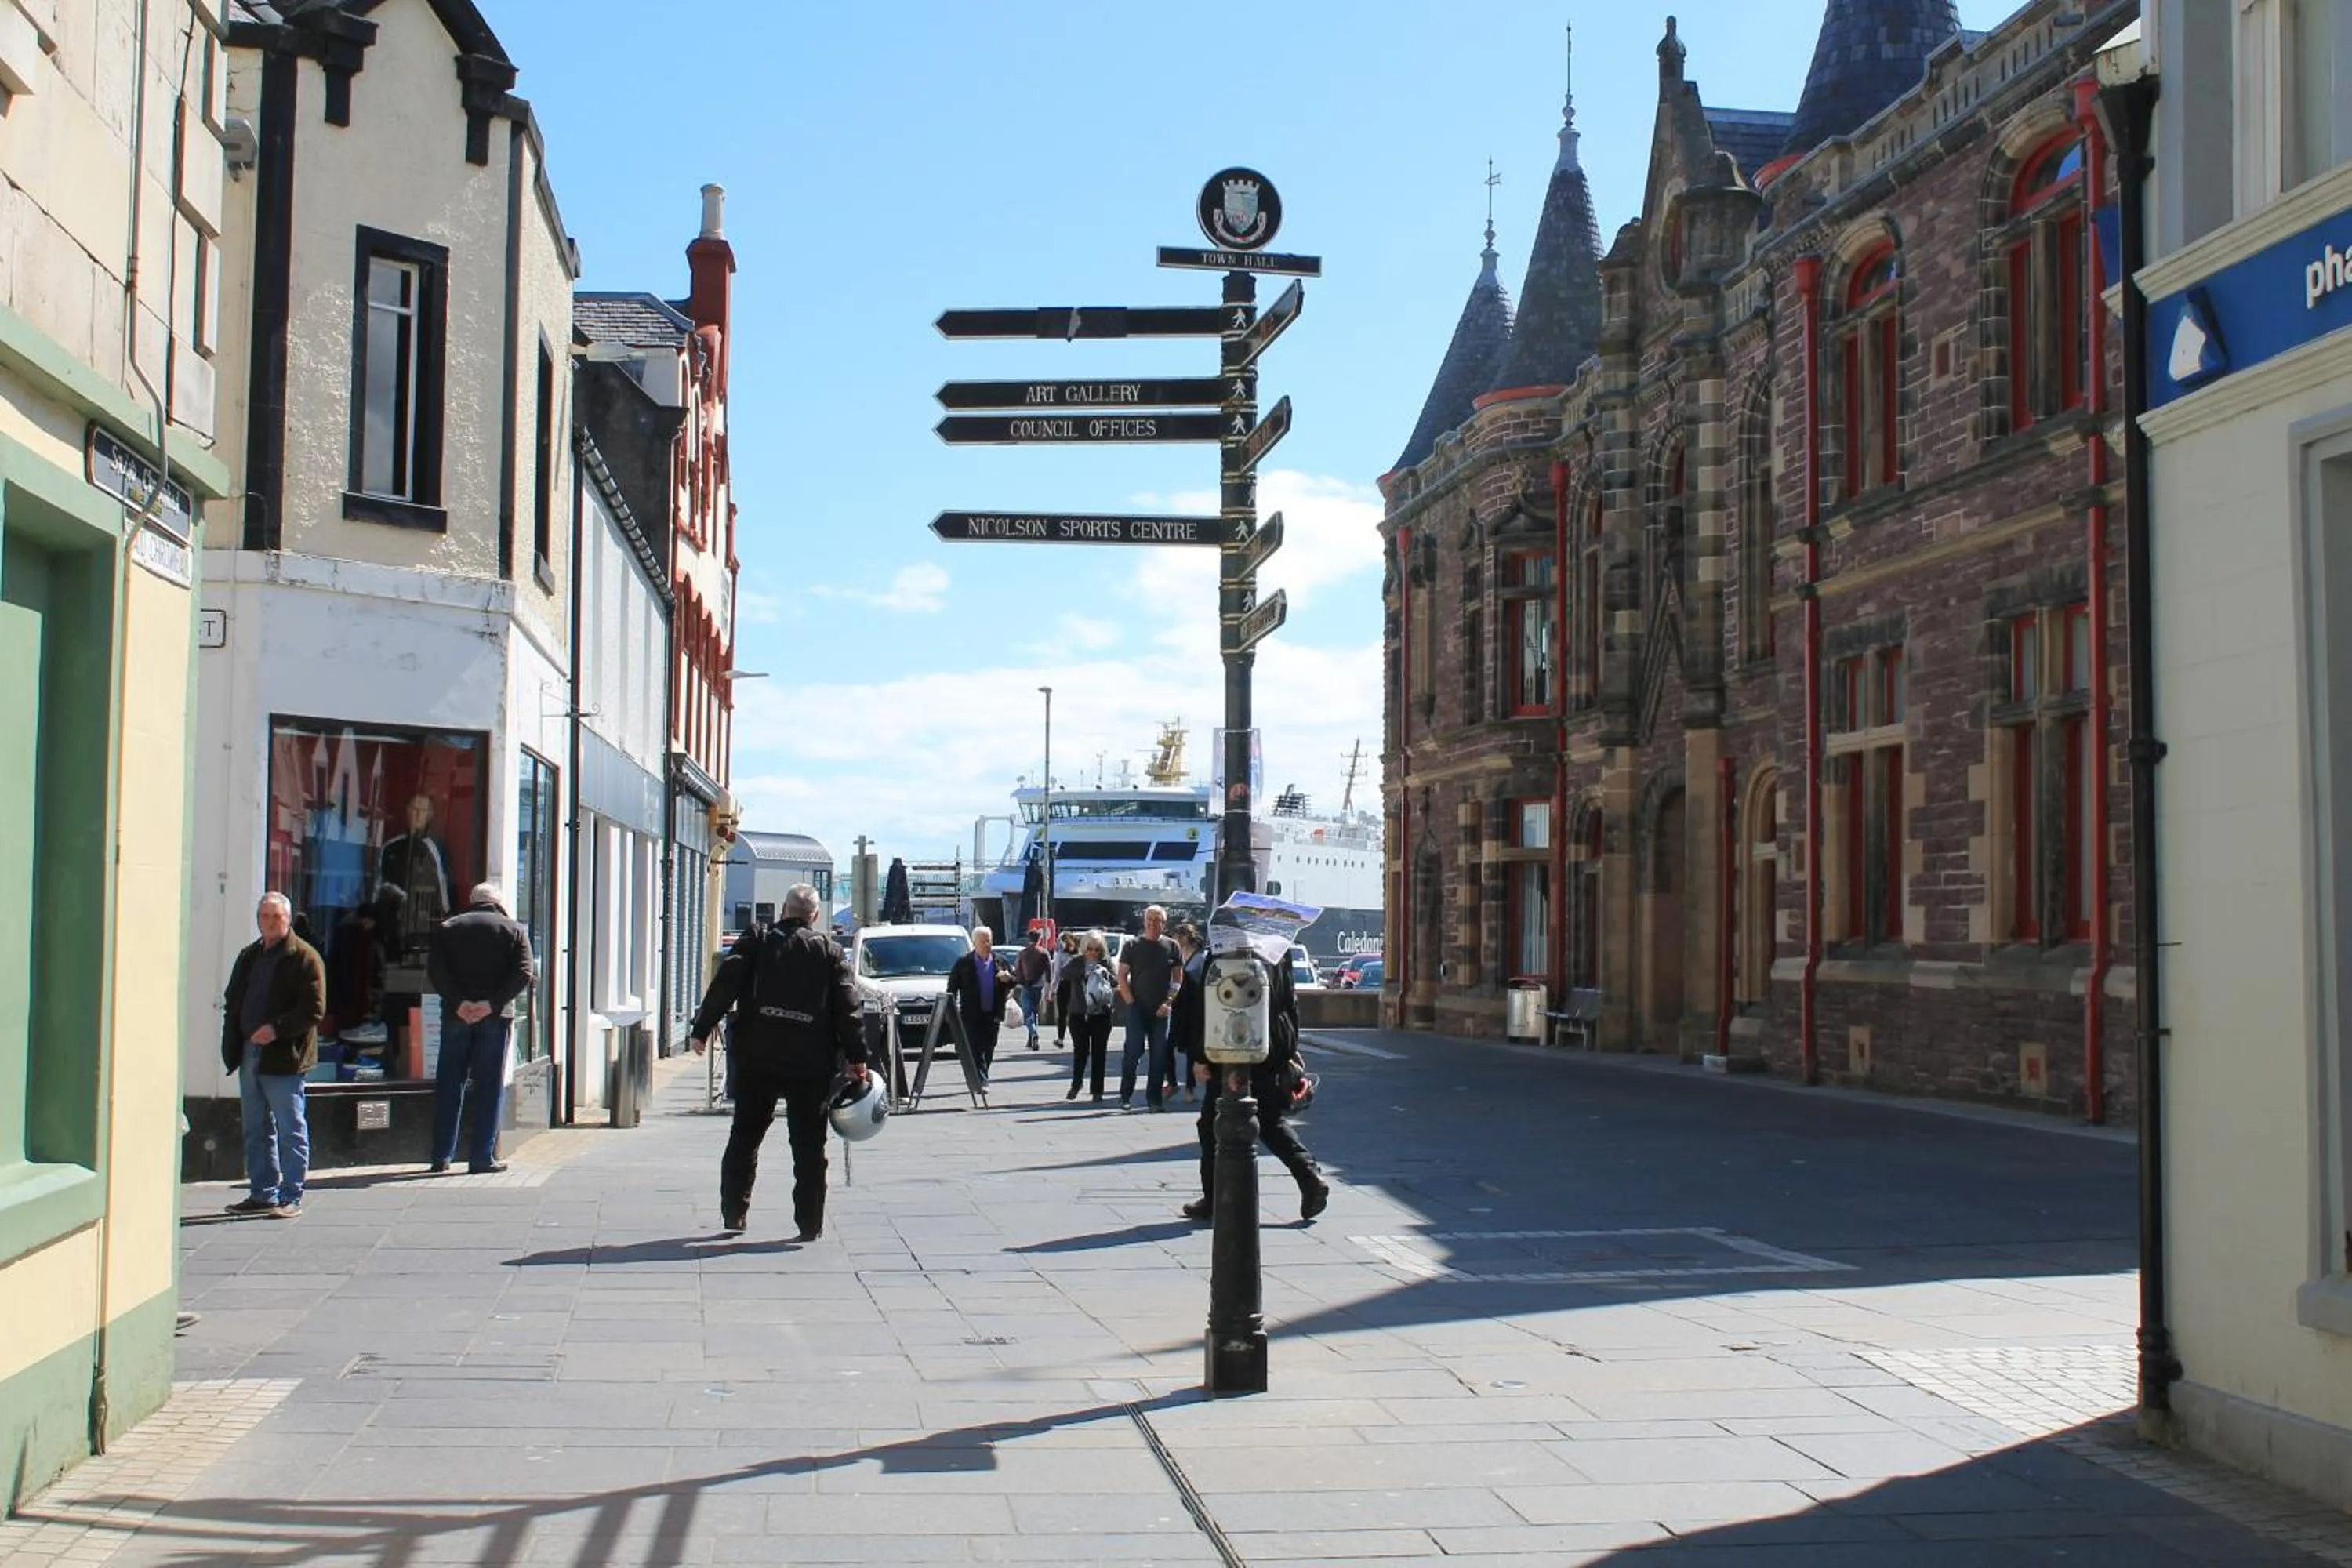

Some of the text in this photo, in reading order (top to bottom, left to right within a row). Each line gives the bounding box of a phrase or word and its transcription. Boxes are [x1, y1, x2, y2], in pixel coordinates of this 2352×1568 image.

[1203, 252, 1276, 268] TOWN HALL
[1025, 384, 1141, 403] ART GALLERY
[1010, 419, 1156, 437] COUNCIL OFFICES
[967, 517, 1197, 540] NICOLSON SPORTS CENTRE
